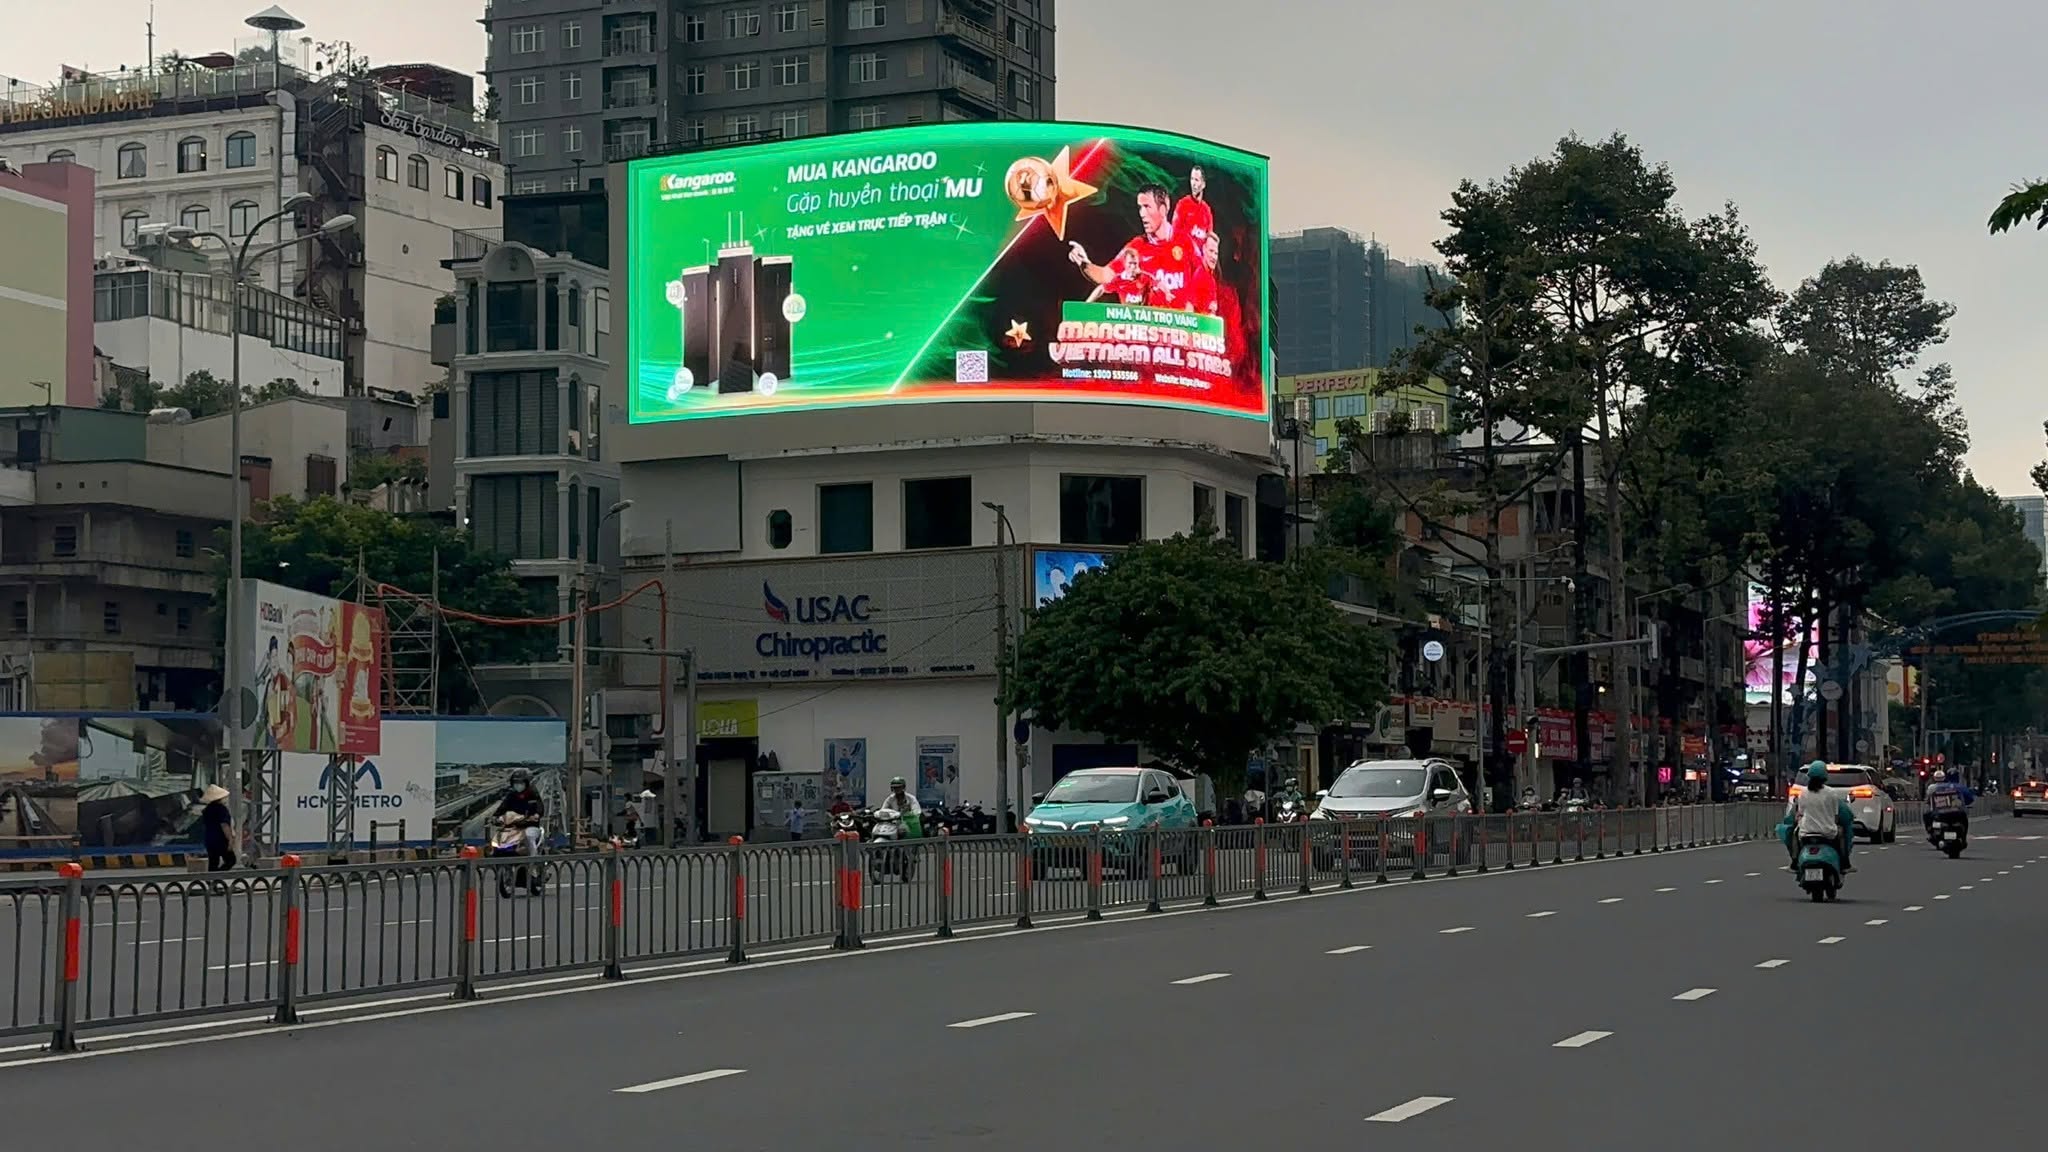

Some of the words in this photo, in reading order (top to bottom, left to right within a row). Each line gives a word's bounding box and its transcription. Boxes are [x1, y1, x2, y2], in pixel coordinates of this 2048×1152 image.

[41, 97, 102, 119] GRAND
[103, 88, 154, 113] HOTEL
[380, 110, 409, 132] Sky
[412, 114, 461, 147] Garden
[787, 162, 828, 184] MUA
[831, 151, 938, 178] KANGAROO
[786, 191, 821, 215] Gặp
[828, 181, 882, 209] huyền
[889, 178, 940, 203] thoại
[944, 177, 984, 199] MU
[831, 220, 855, 234] XEM
[858, 216, 886, 232] TRỰC
[887, 211, 913, 228] TIẾP
[914, 211, 948, 229] TRẬN
[1106, 305, 1132, 321] NHÀ
[1133, 306, 1150, 323] TÀI
[1151, 311, 1173, 325] TRỢ
[1174, 311, 1198, 329] VÀNG
[1057, 320, 1190, 347] MANCHESTER
[1191, 331, 1226, 355] REDS
[1048, 342, 1150, 365] VIETNAM
[1152, 345, 1185, 367] ALL
[1186, 350, 1232, 378] STARS
[1296, 373, 1369, 394] PERFECT
[795, 594, 870, 623] USAC
[755, 628, 888, 662] Chiropractic
